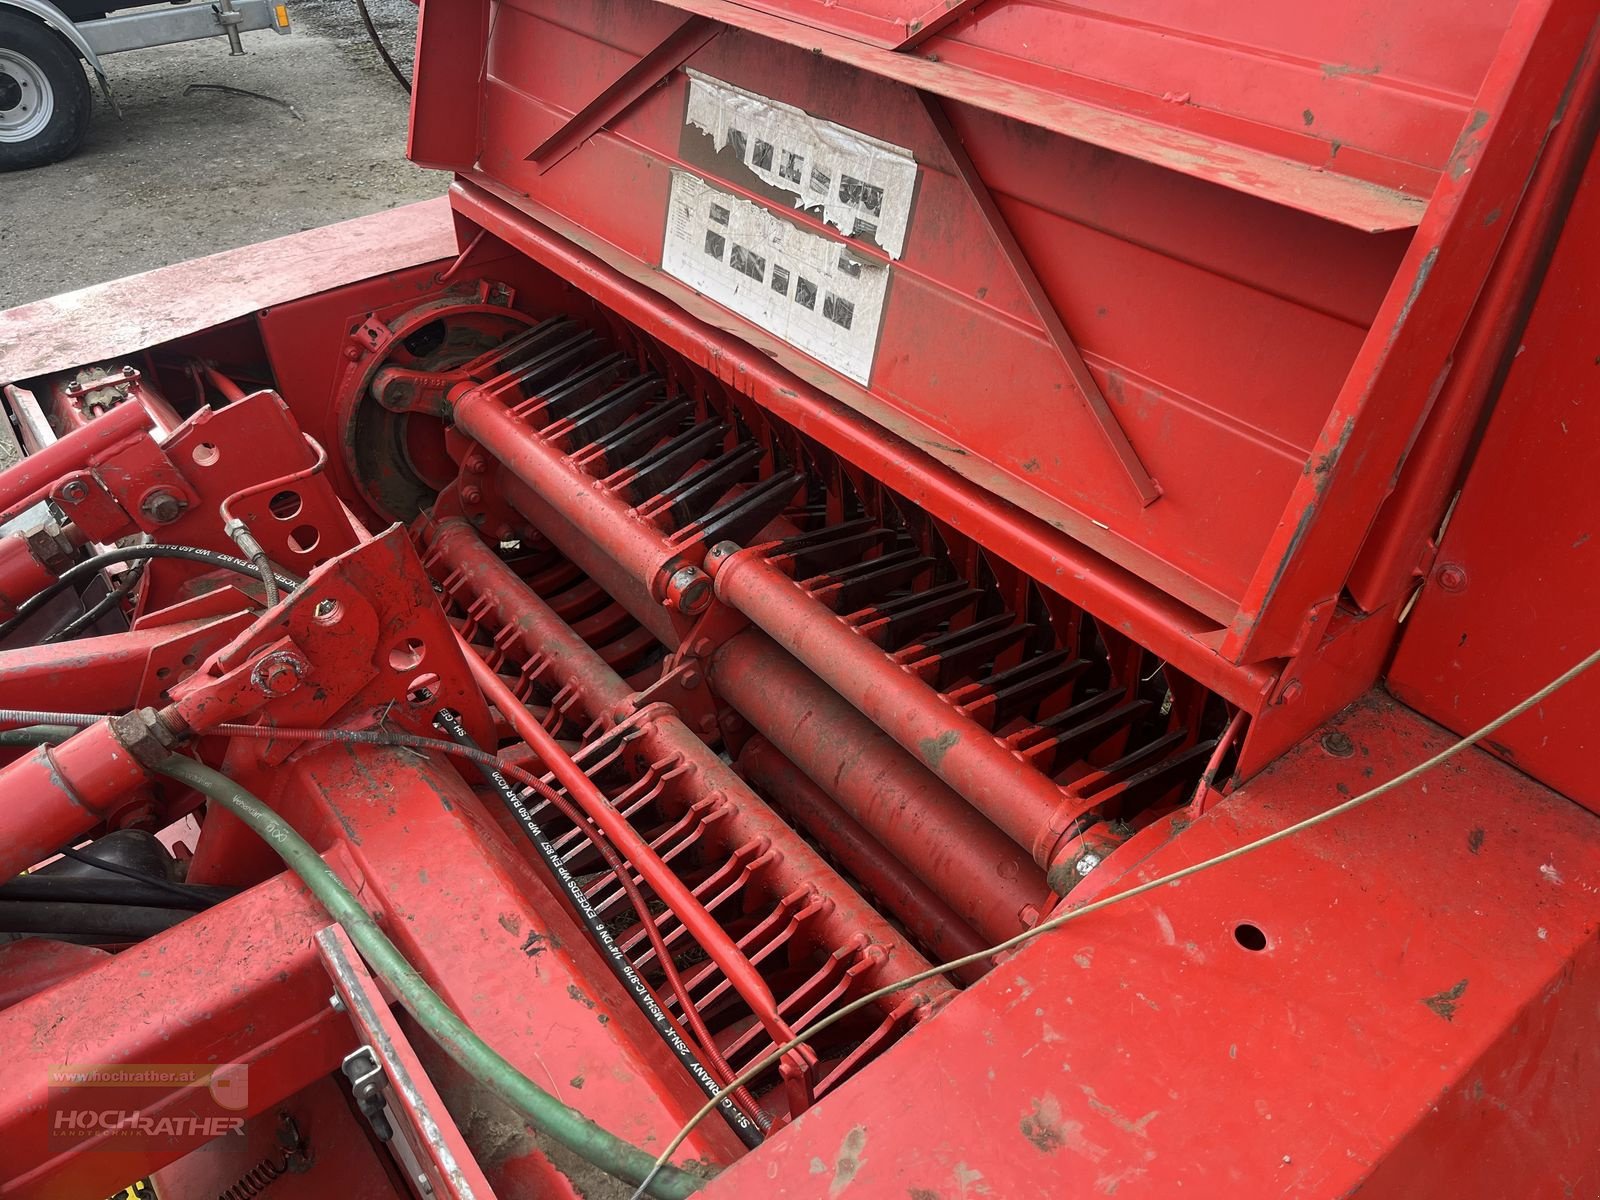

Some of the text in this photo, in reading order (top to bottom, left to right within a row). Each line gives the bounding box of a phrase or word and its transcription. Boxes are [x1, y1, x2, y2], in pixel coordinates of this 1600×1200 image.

[194, 548, 211, 557] WP
[453, 725, 467, 737] SH
[506, 790, 523, 808] BAR
[518, 807, 532, 821] 450
[527, 821, 541, 837] WP
[541, 841, 555, 855] 857
[550, 854, 563, 868] EN
[558, 867, 572, 882] WP
[567, 880, 597, 919] EXCEEDS
[599, 930, 613, 944] DN
[623, 966, 648, 995] IC-8/19
[643, 995, 666, 1022] MSHA
[664, 1026, 691, 1056] 2SN-K
[690, 1062, 733, 1108] GRMANY
